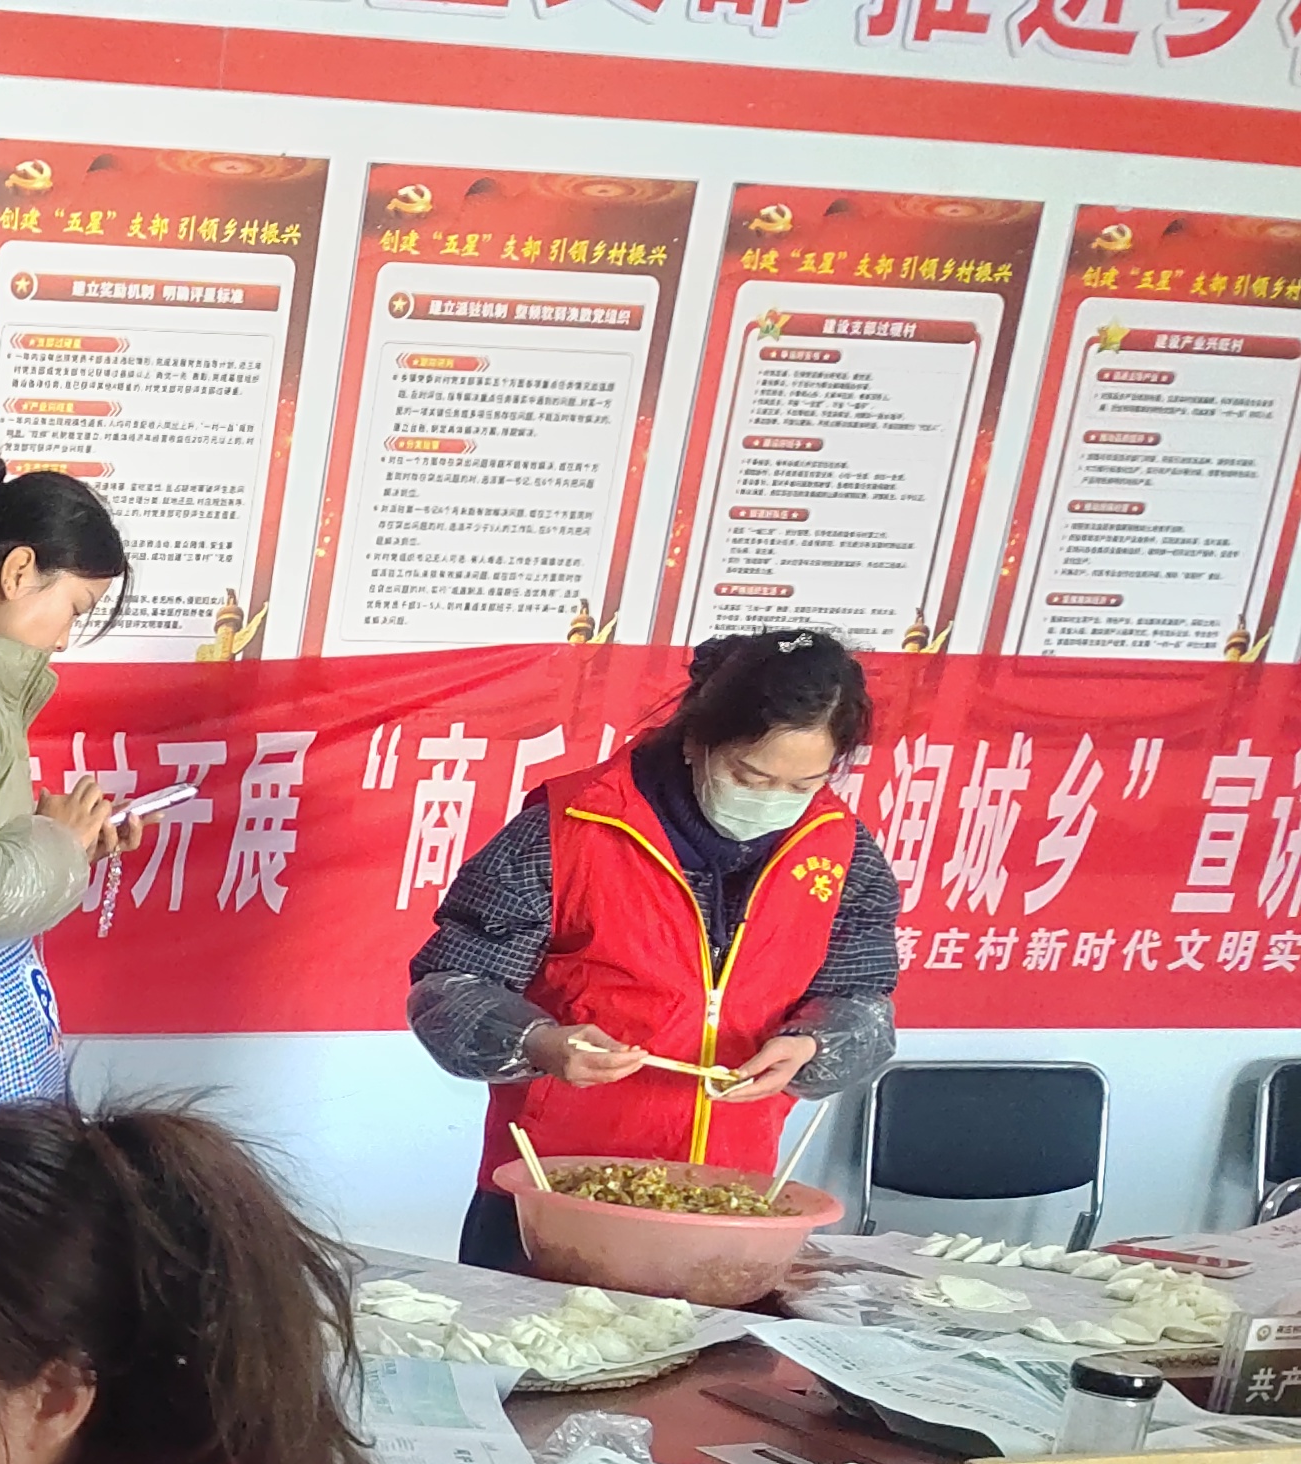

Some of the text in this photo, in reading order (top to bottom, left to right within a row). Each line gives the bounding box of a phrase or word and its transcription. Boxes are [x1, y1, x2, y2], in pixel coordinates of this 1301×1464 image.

[177, 216, 302, 246] 引领乡村振兴
[549, 237, 668, 267] 引领乡村振兴
[900, 256, 1013, 285] 引领乡村振兴
